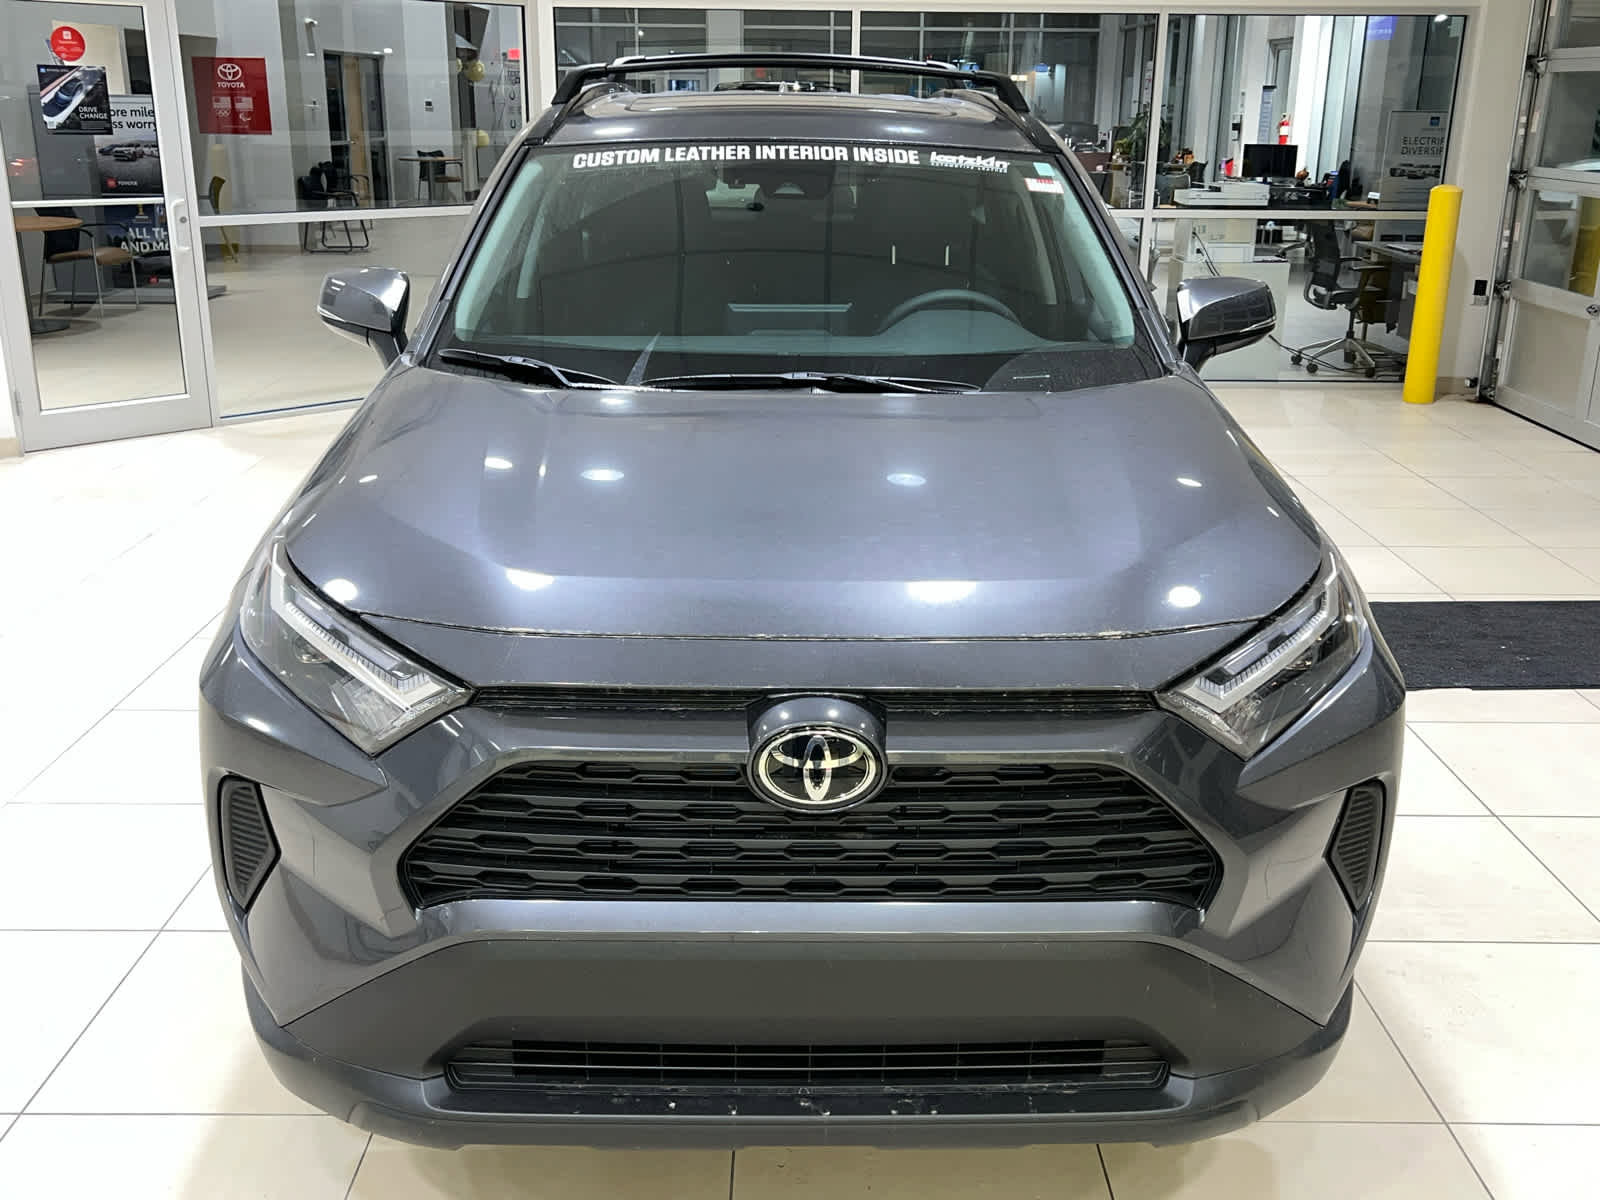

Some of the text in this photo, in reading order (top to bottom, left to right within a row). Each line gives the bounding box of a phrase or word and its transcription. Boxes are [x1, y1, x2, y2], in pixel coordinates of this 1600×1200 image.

[572, 148, 660, 169] CUSTOM
[664, 145, 751, 162] LEATHER
[755, 144, 849, 161] INTERIOR
[853, 146, 920, 165] INSIDE
[128, 227, 150, 239] ALL
[121, 241, 149, 253] AND
